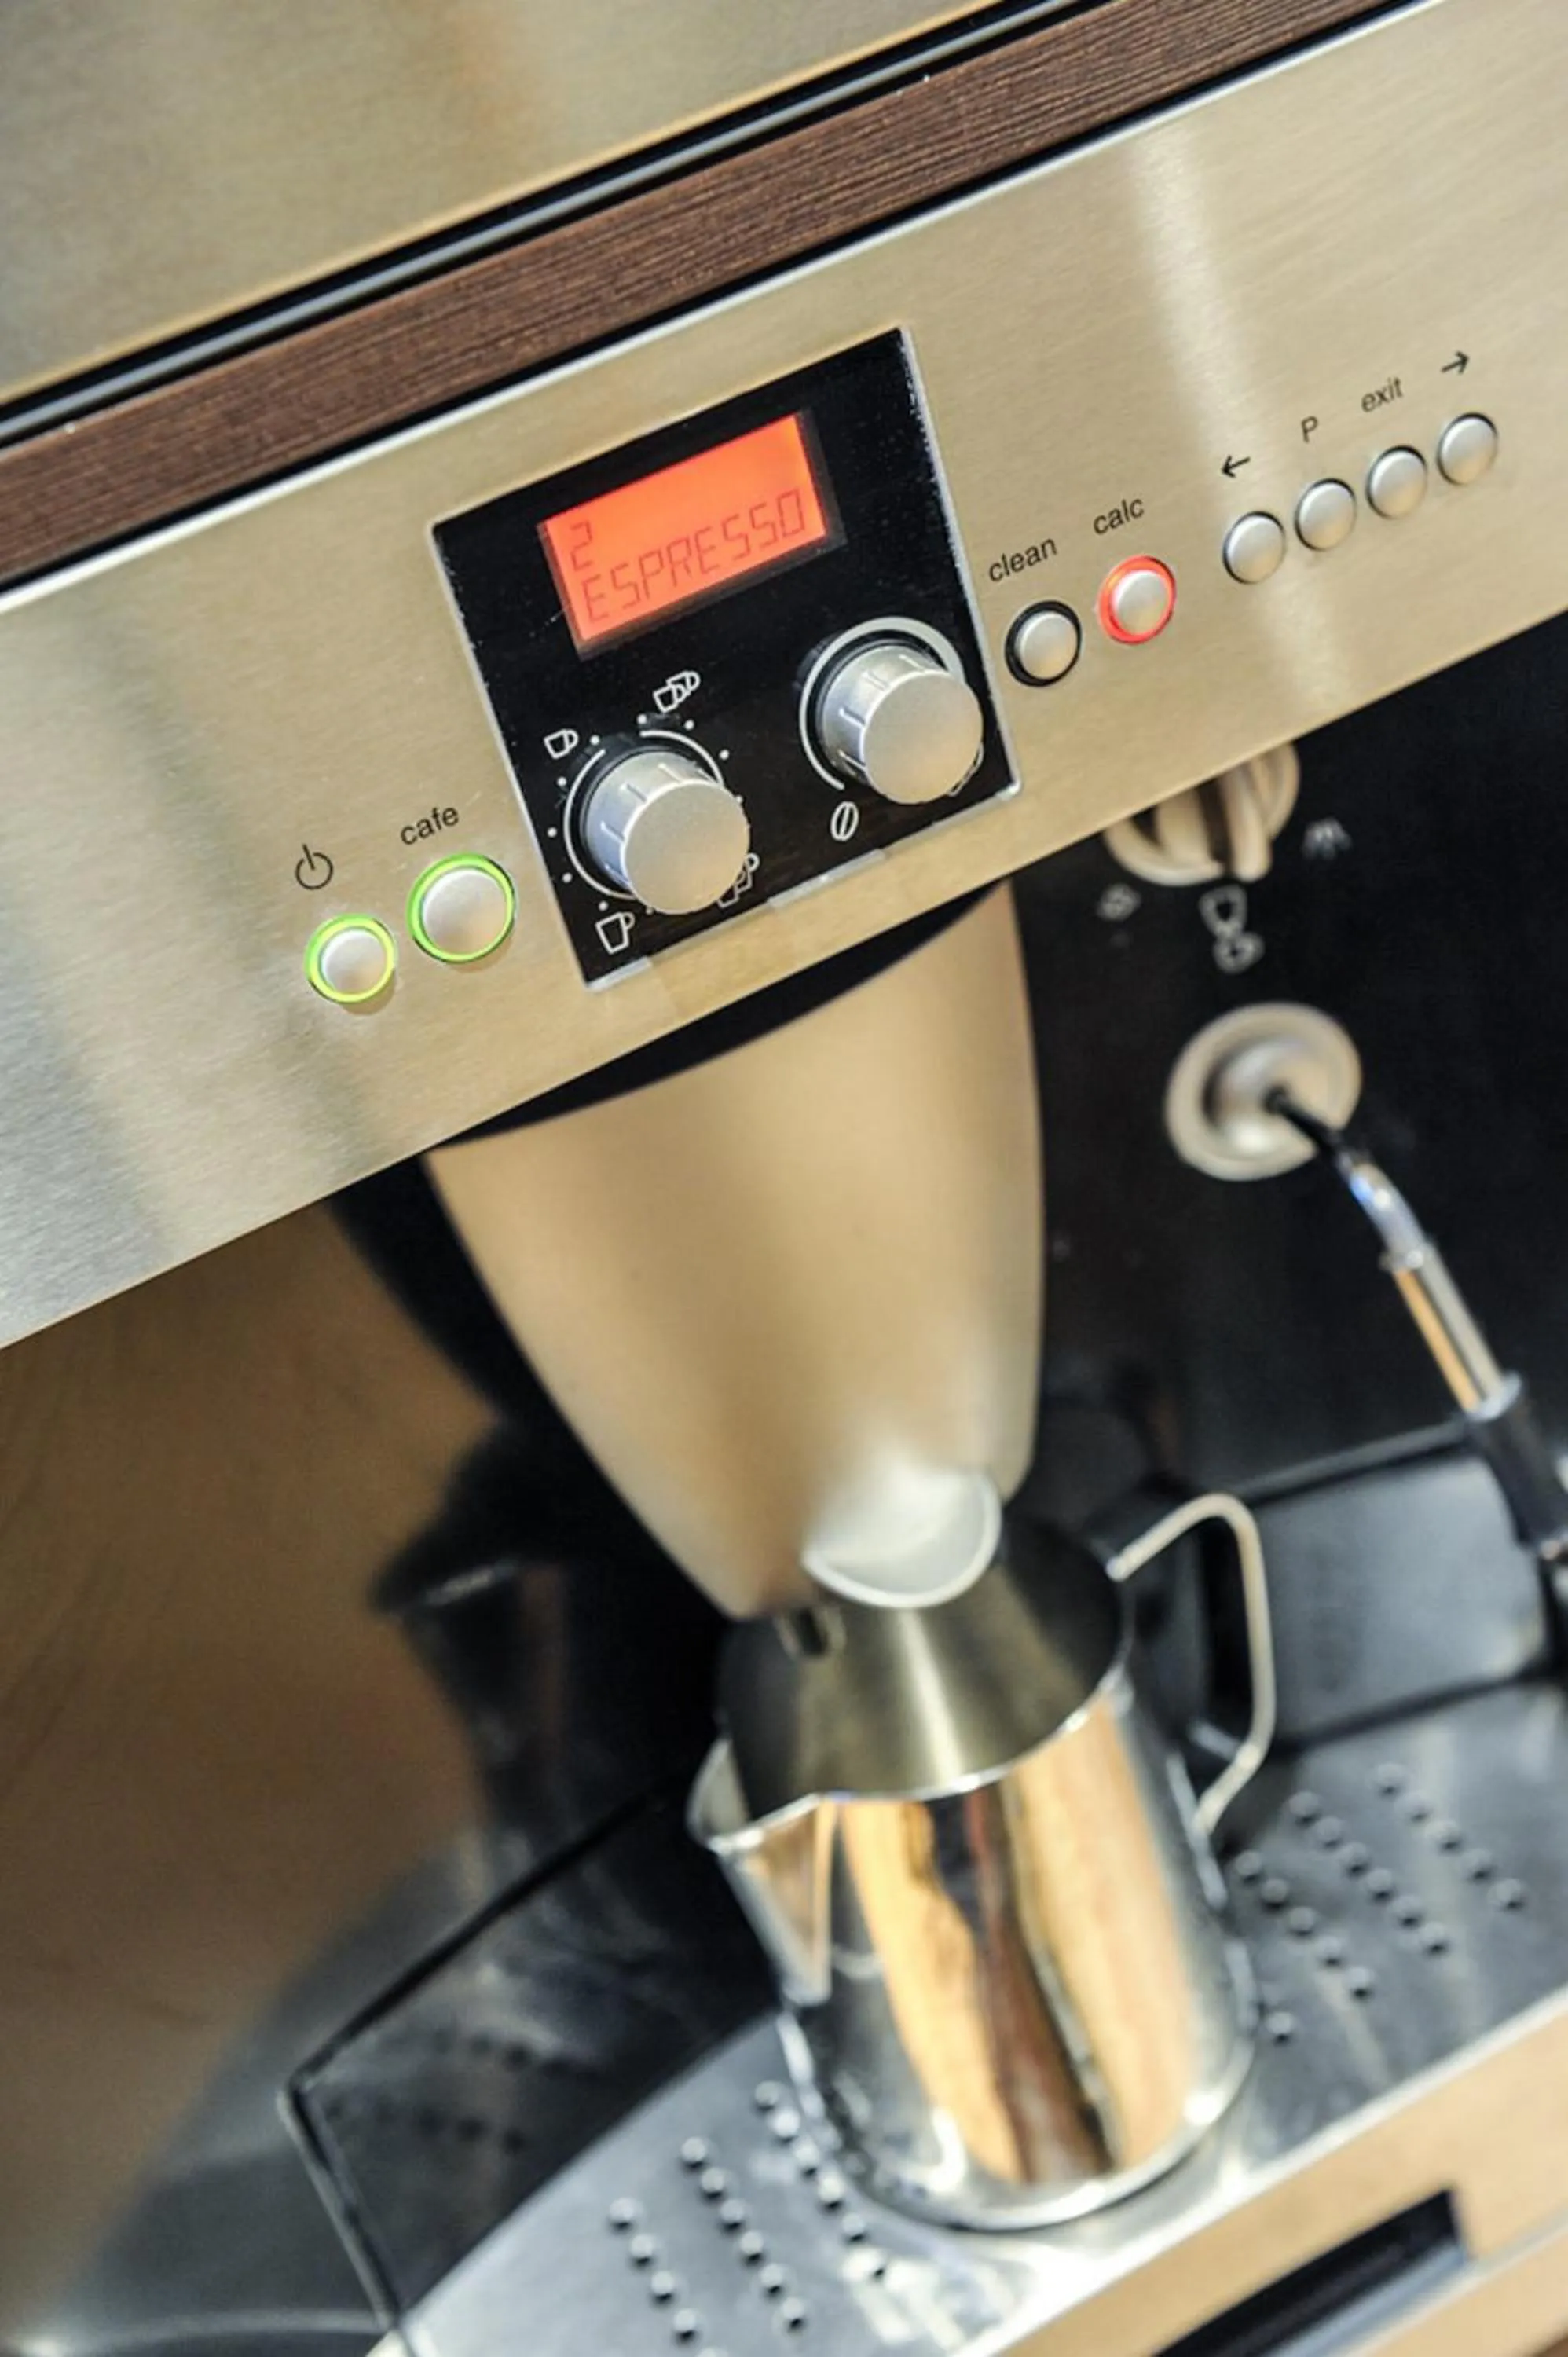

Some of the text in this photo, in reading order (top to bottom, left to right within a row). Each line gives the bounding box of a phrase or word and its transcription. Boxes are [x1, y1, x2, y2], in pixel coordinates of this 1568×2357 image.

[1361, 377, 1403, 412] exit
[1300, 416, 1318, 442] P
[1093, 497, 1145, 535] calc
[570, 521, 592, 572] 2
[583, 489, 806, 623] ESPRESSO
[988, 537, 1058, 583] clean
[400, 806, 459, 845] cafe
